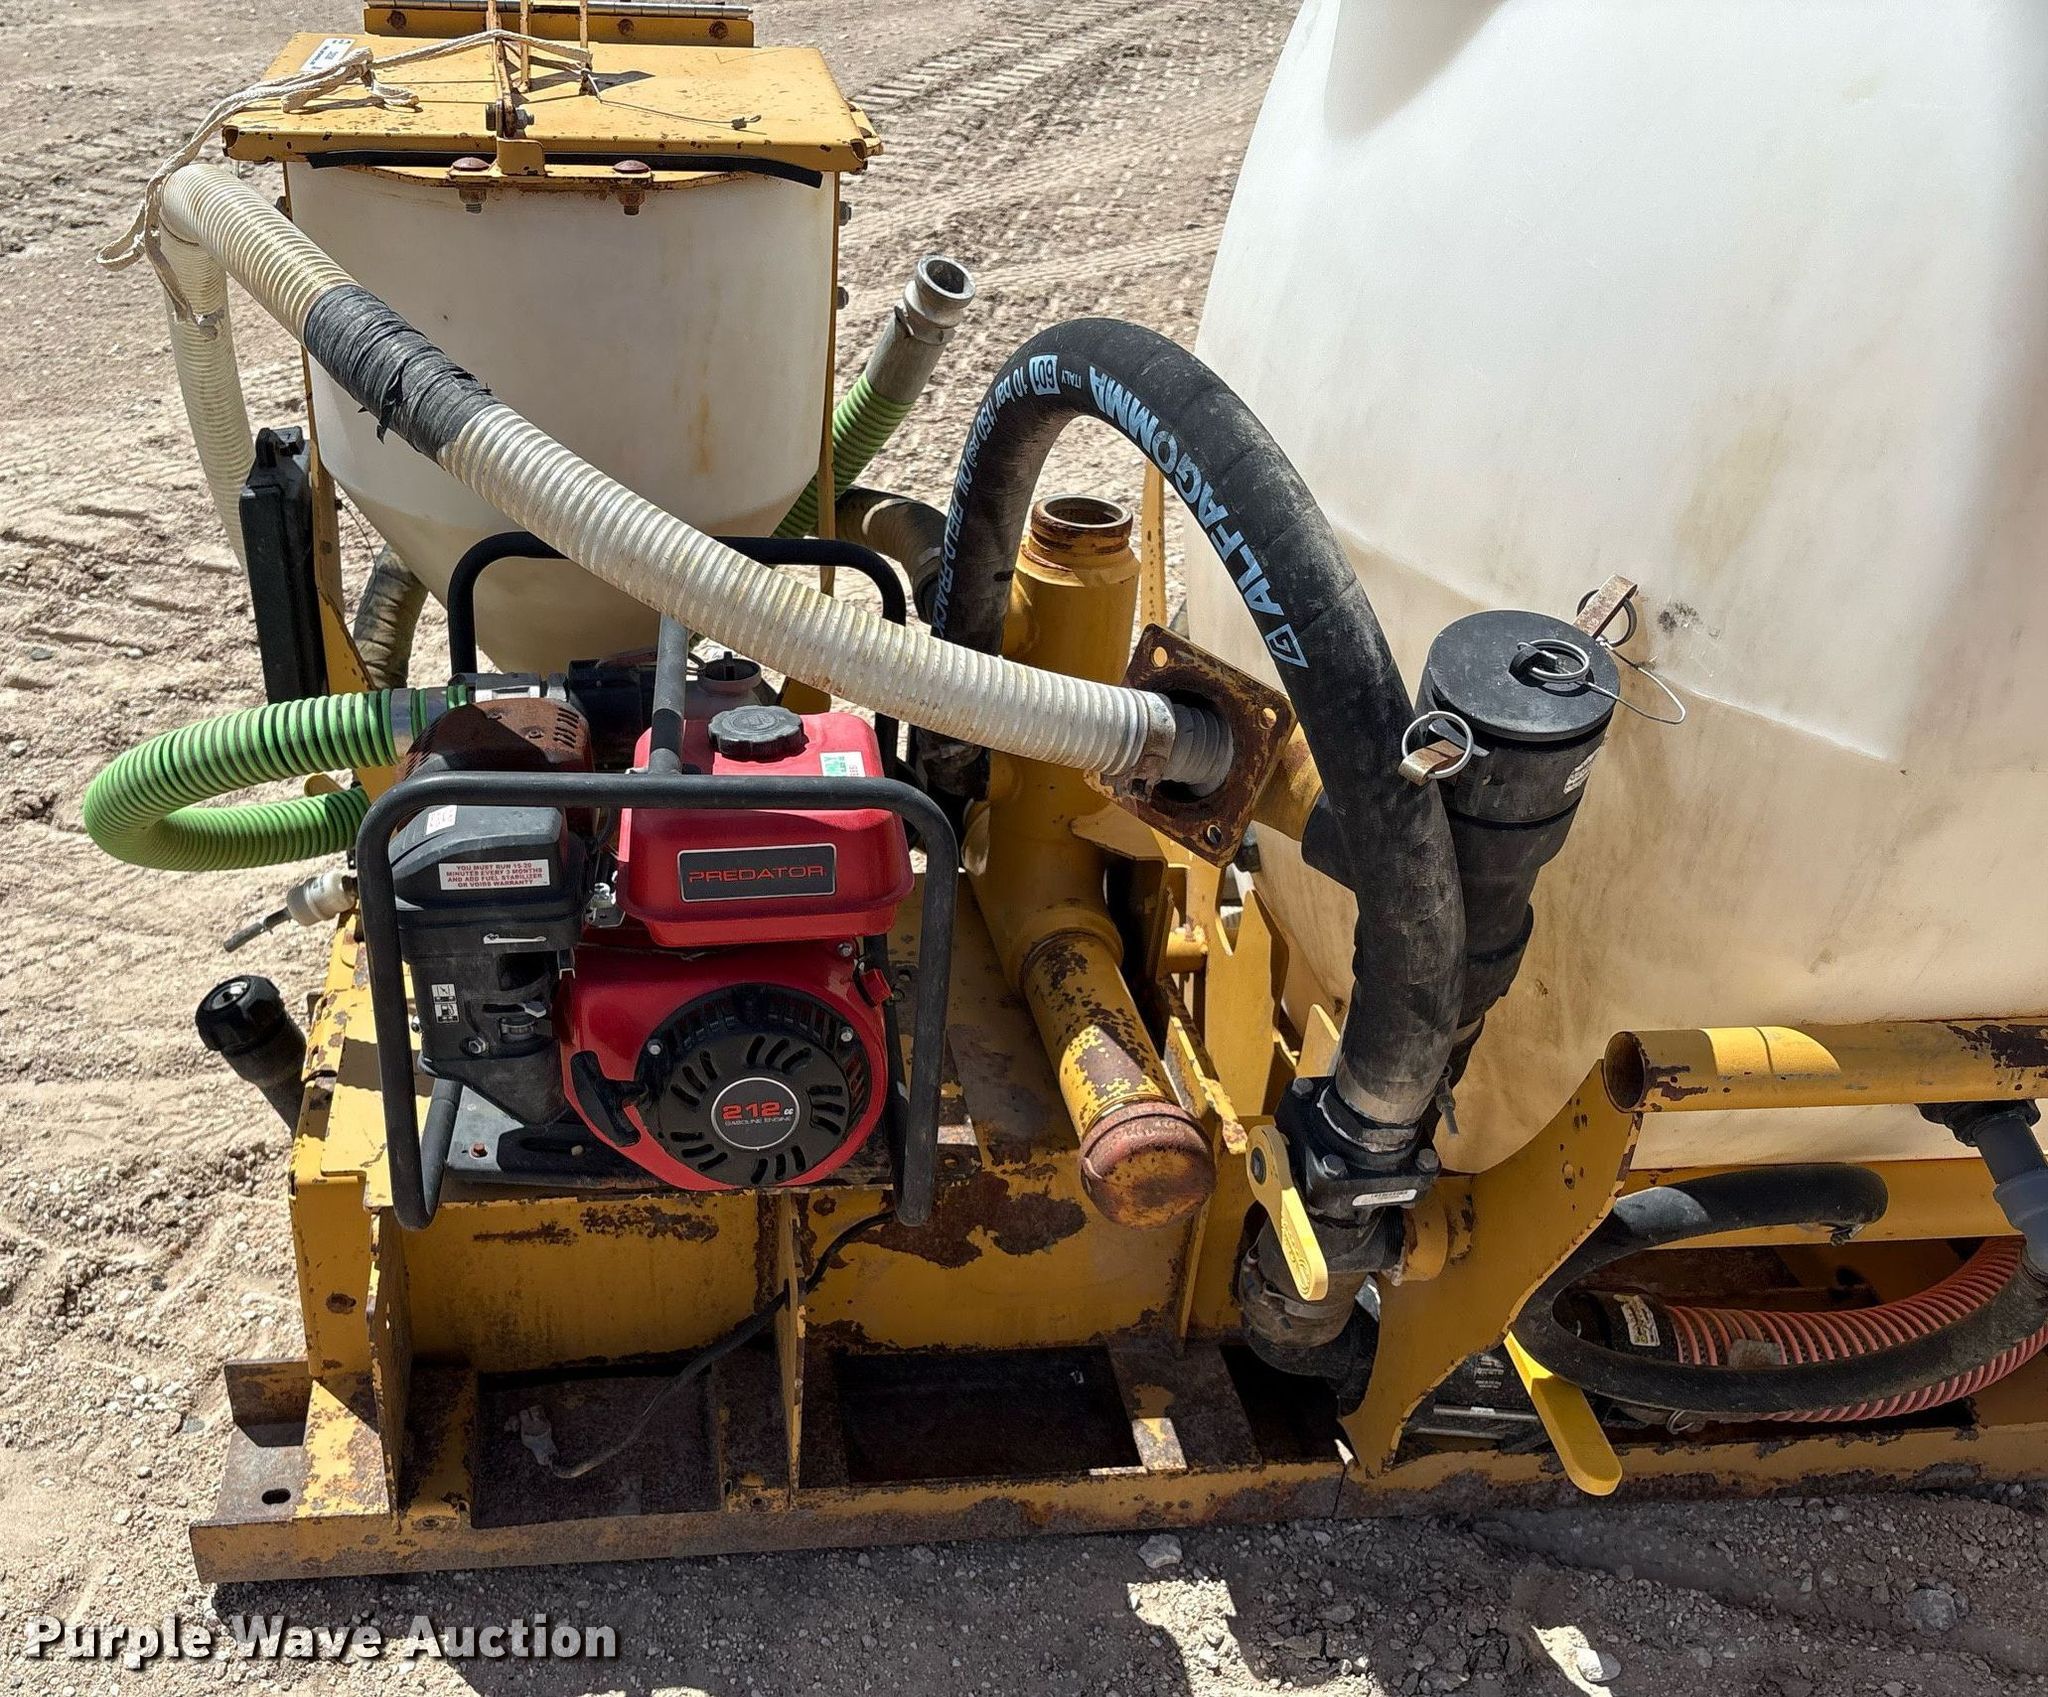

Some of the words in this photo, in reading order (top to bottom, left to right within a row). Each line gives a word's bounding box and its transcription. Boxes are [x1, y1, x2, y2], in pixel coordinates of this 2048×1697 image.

[1012, 366, 1029, 398] 10
[1031, 358, 1056, 391] 601
[1061, 369, 1082, 390] ITALY
[994, 375, 1015, 411] bar
[956, 457, 973, 497] OIL
[1089, 365, 1285, 617] ALFAGOMMA
[688, 865, 825, 884] PREDATOR
[722, 1101, 781, 1120] 212
